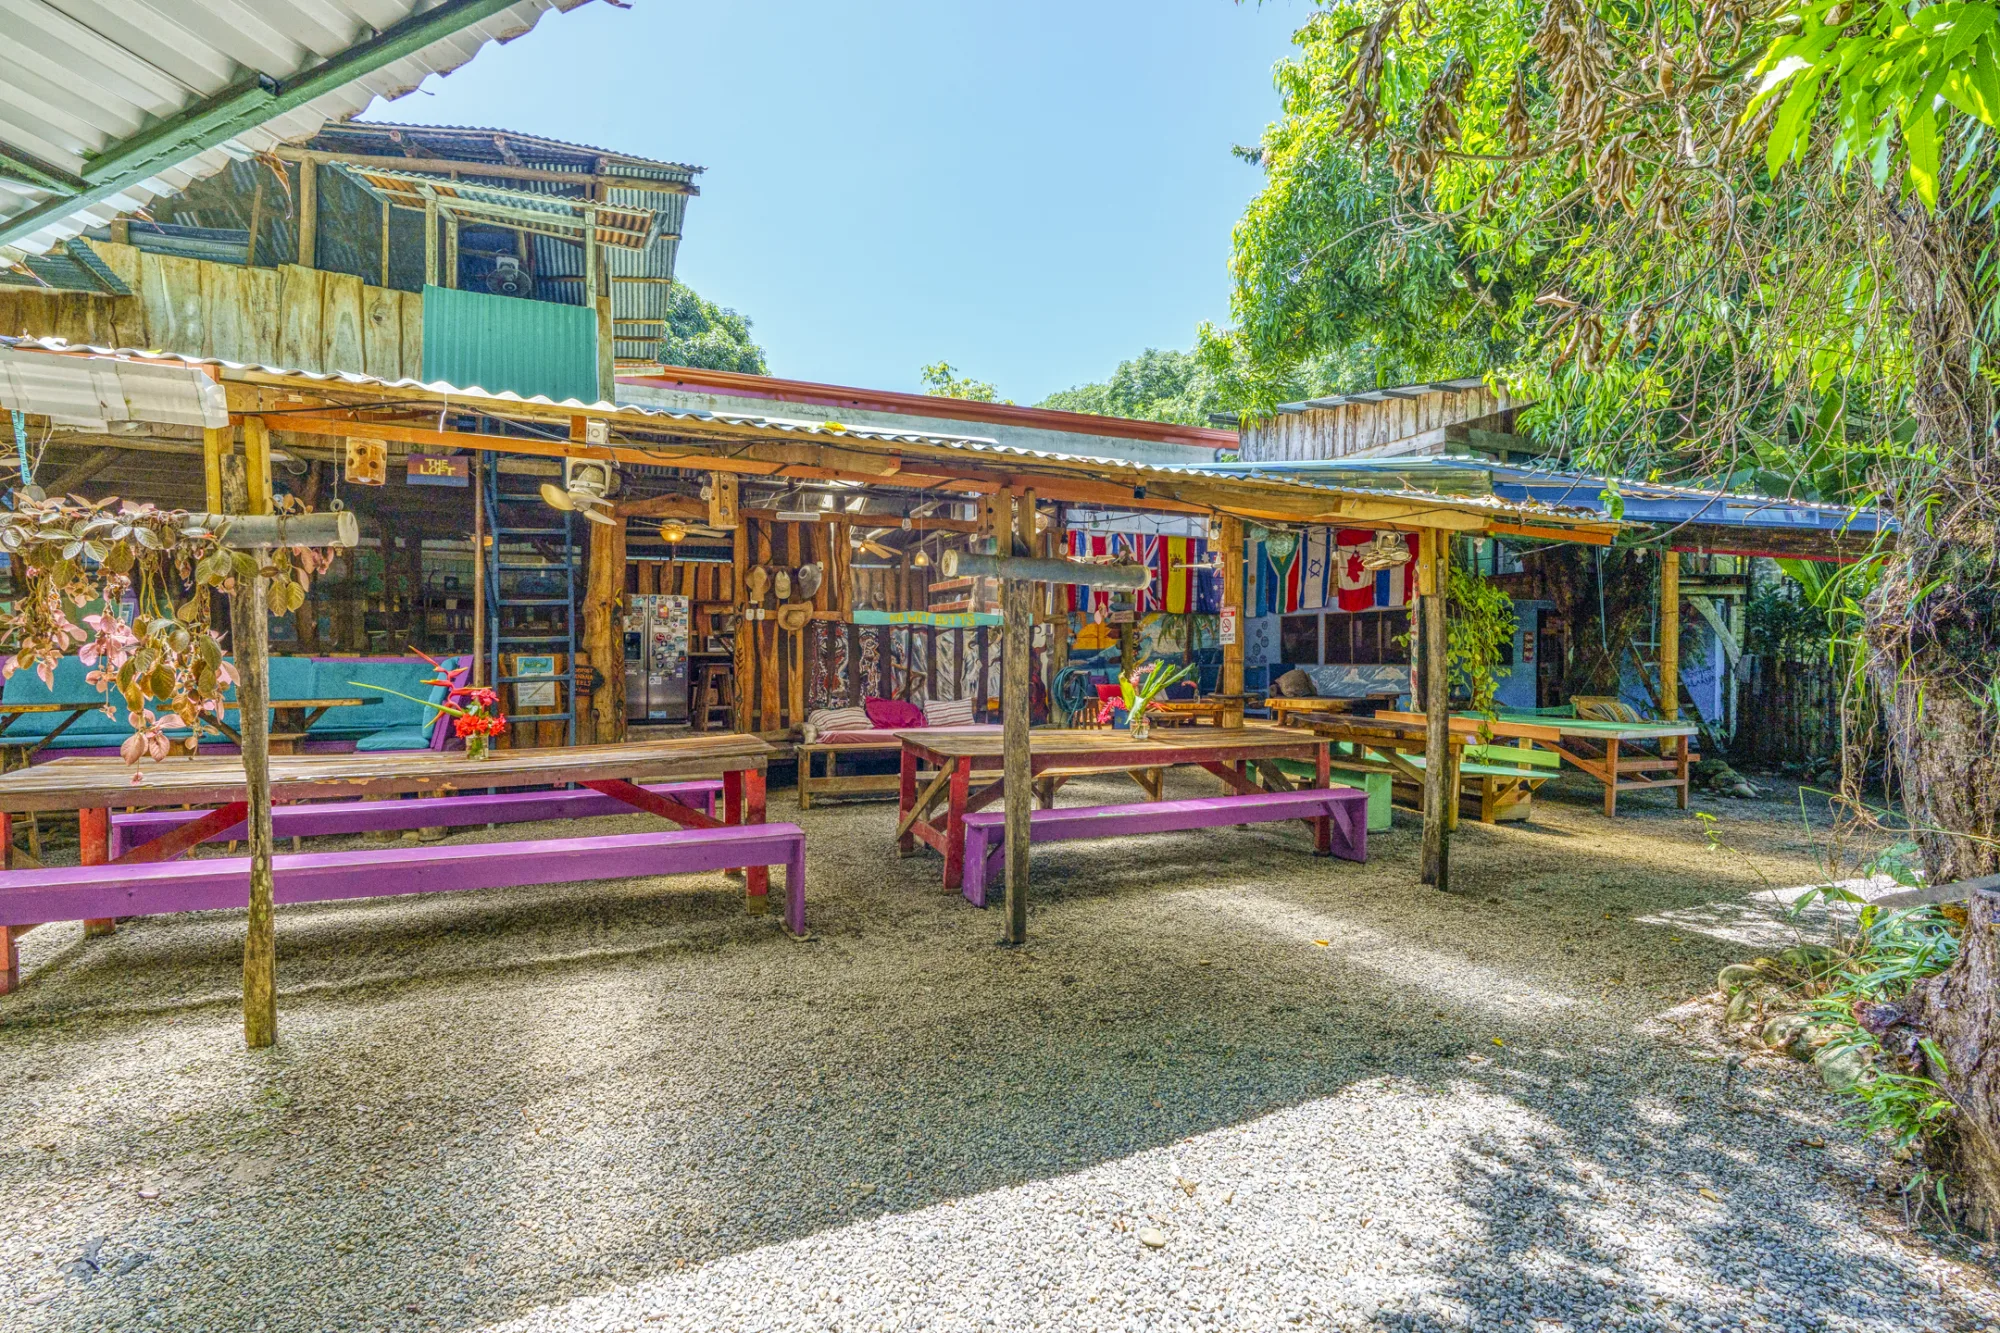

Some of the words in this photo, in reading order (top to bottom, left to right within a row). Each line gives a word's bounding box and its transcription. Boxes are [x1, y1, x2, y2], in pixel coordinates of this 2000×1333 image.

[424, 458, 449, 467] THE
[420, 464, 456, 476] LOFT
[889, 612, 904, 623] NO
[907, 611, 931, 624] WET
